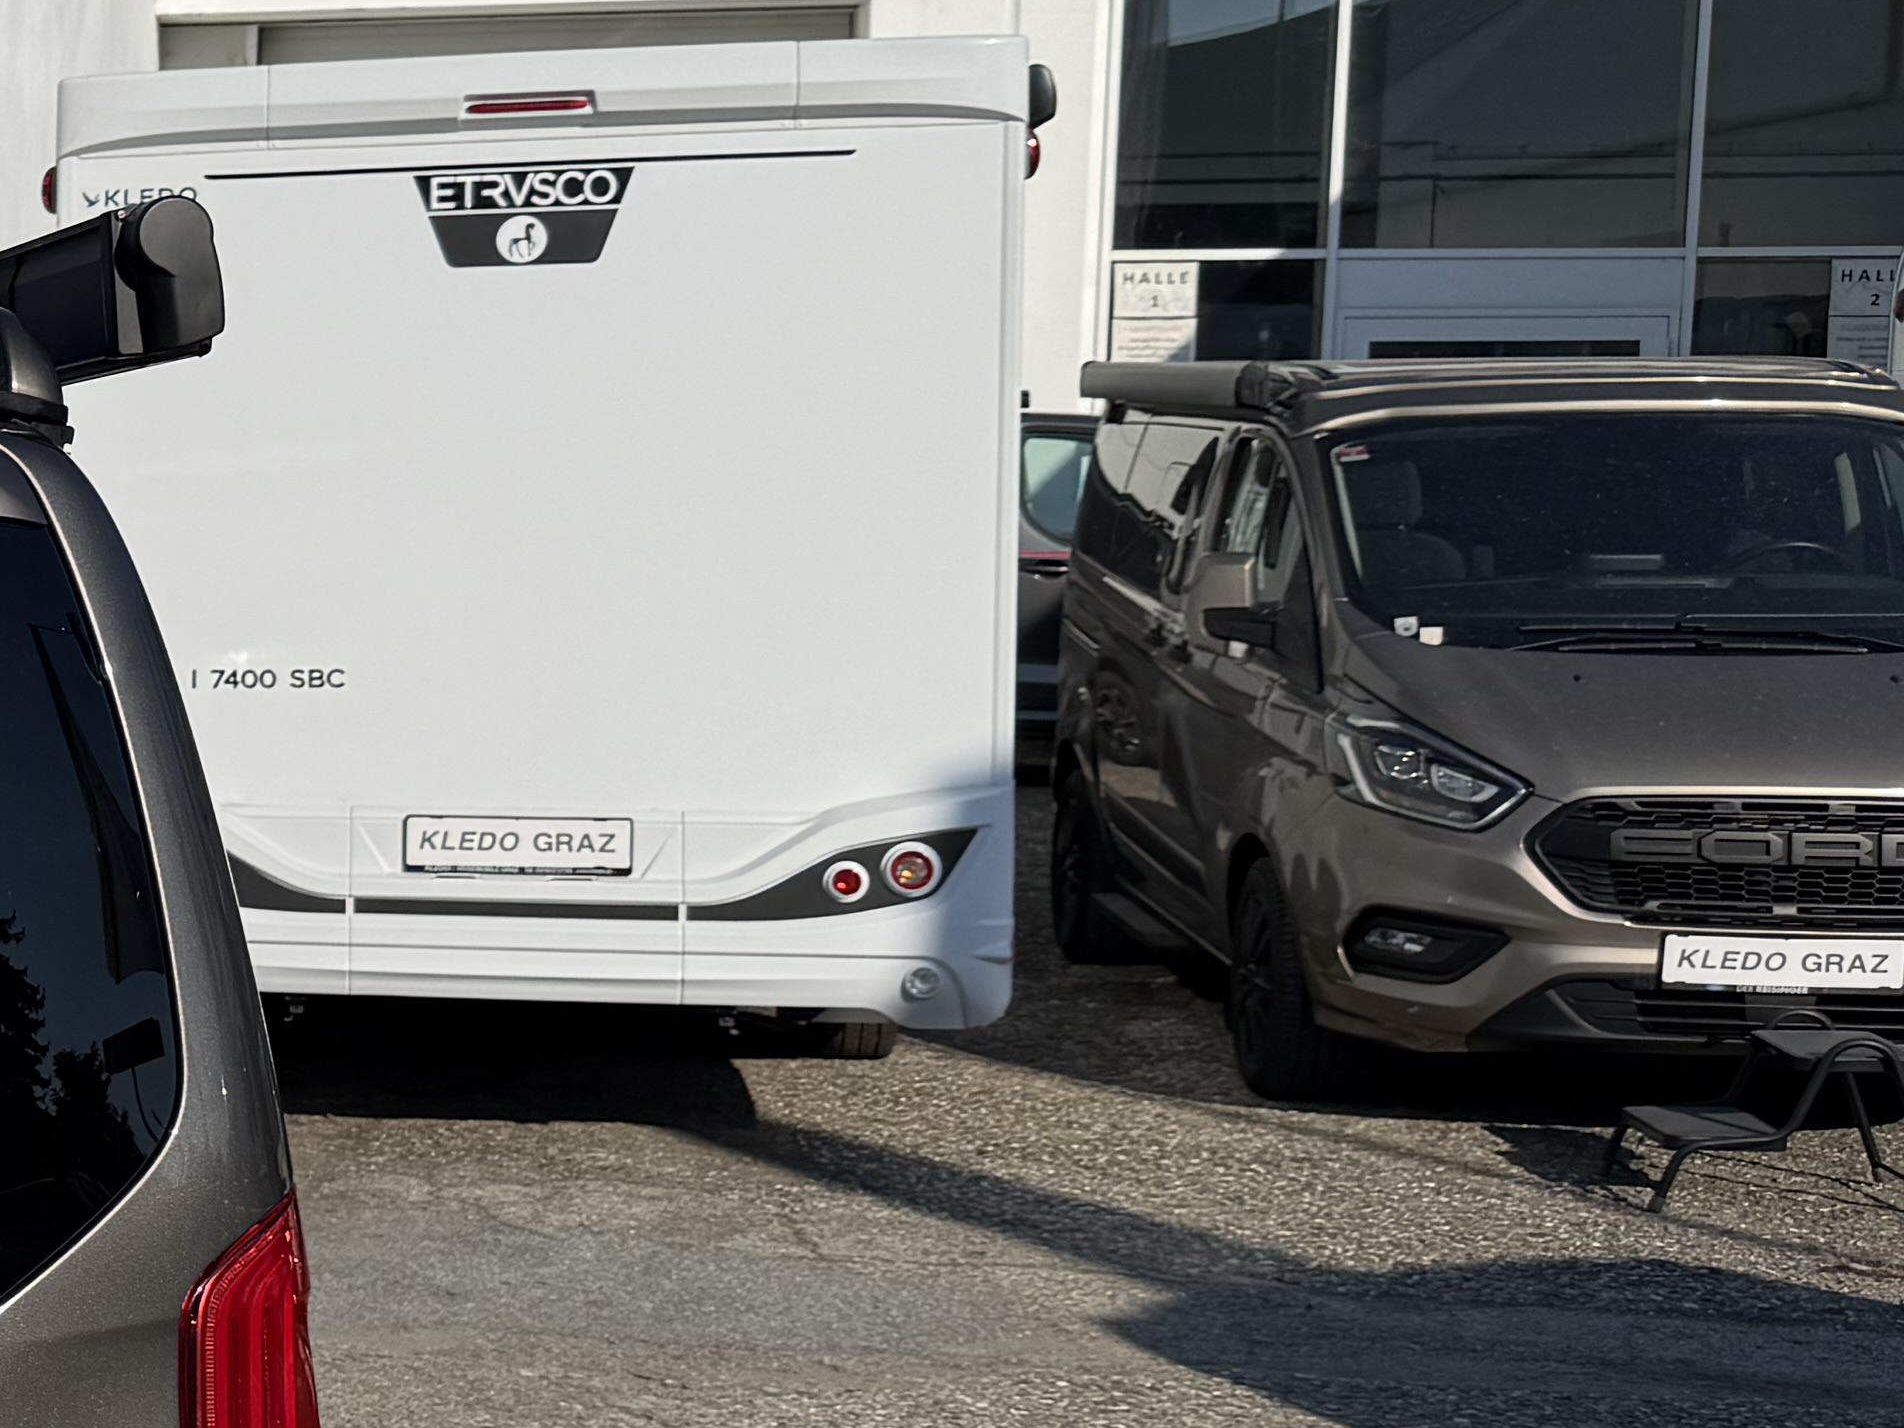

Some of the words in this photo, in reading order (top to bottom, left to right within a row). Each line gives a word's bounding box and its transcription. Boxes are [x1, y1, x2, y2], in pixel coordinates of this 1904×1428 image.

[1122, 270, 1190, 285] HALLE
[1151, 295, 1159, 308] 1
[1870, 293, 1880, 306] 2
[210, 668, 277, 690] 7400
[289, 668, 346, 690] SBC
[419, 830, 520, 852] KLEDO
[533, 832, 616, 853] GRAZ
[1610, 828, 1904, 867] FOR
[1677, 948, 1787, 972] KLEDO
[1801, 952, 1890, 974] GRAZ
